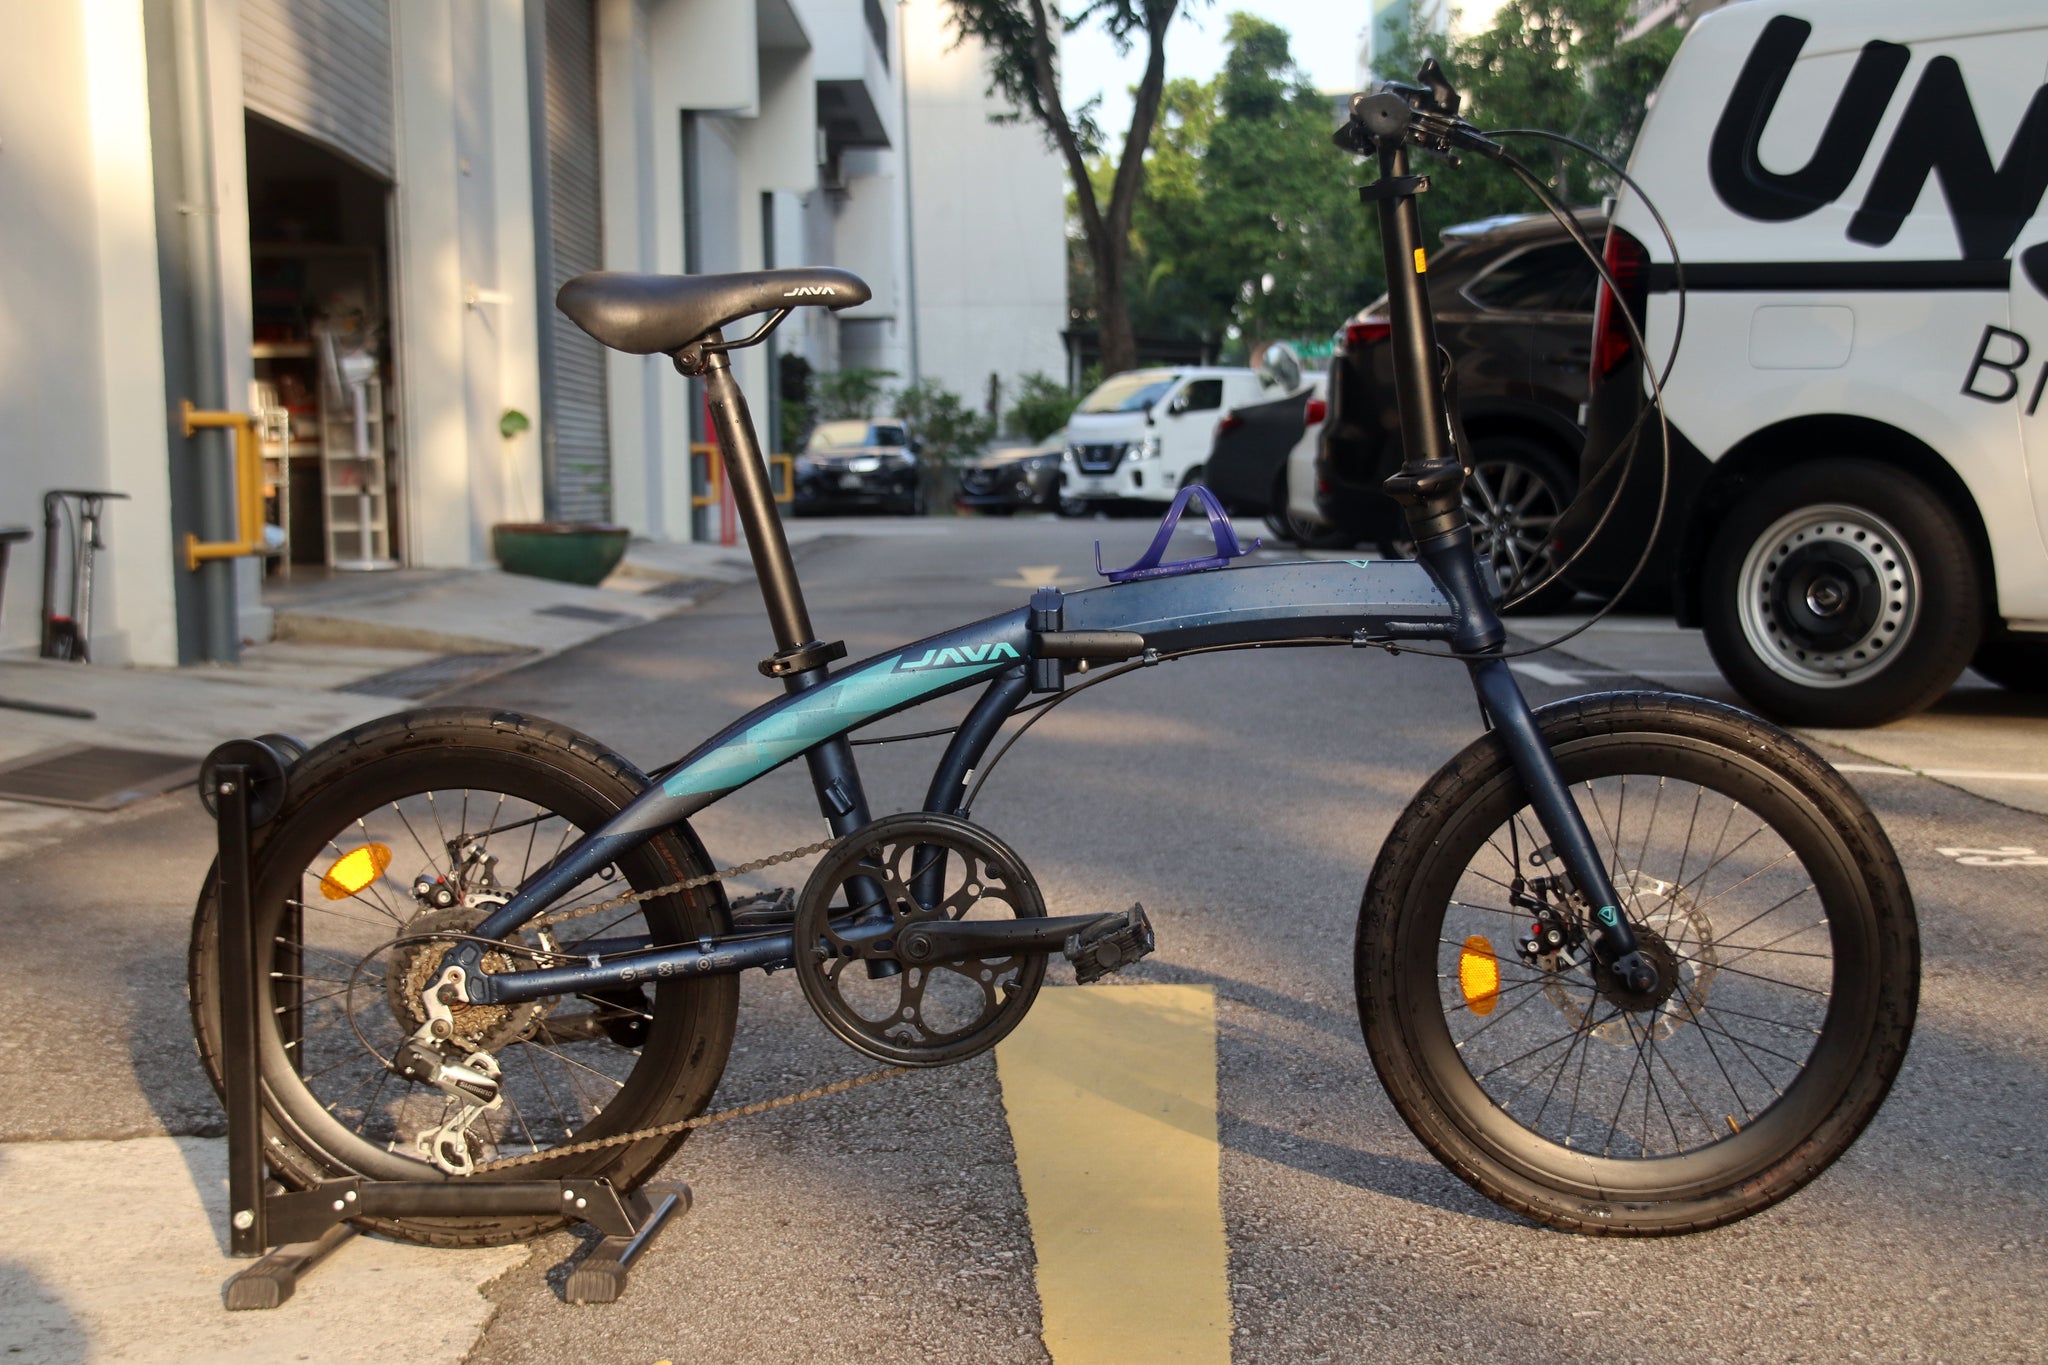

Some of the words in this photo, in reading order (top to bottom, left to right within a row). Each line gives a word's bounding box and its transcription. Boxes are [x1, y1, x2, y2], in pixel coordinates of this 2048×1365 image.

[1708, 14, 2048, 302] UN
[783, 286, 835, 297] JAVA
[900, 642, 1020, 669] JAVA
[460, 1081, 493, 1097] SHIMANO
